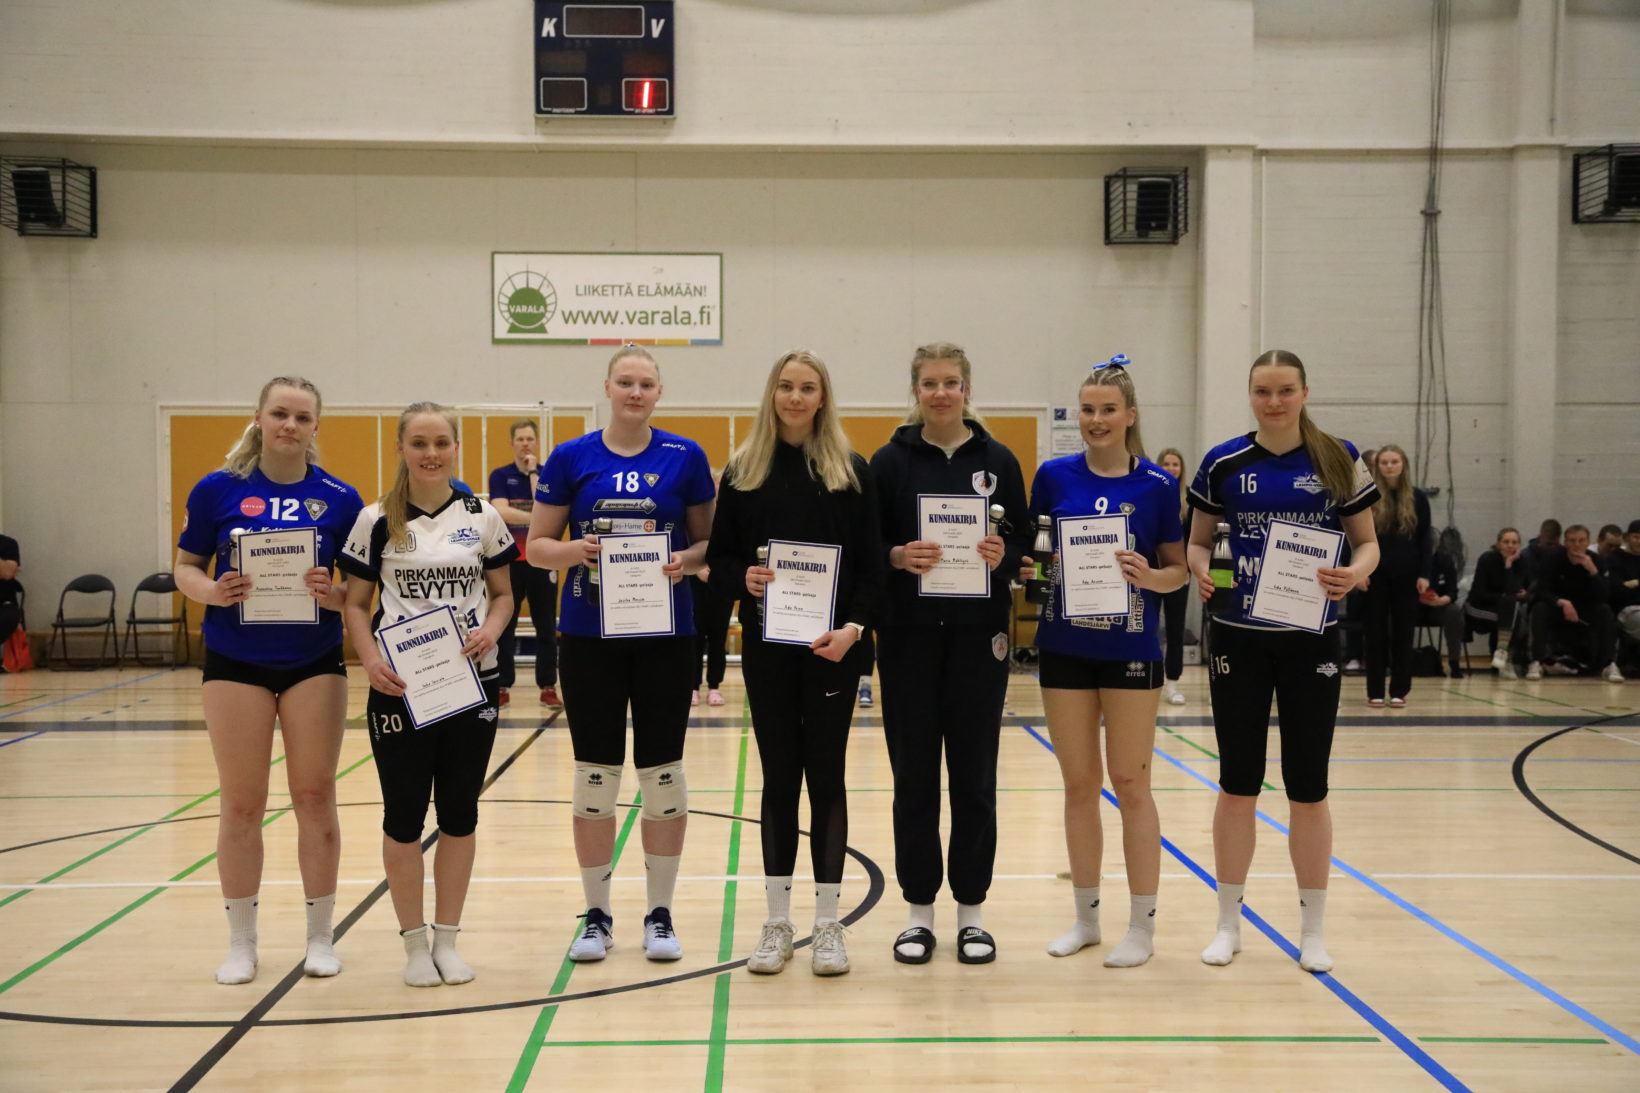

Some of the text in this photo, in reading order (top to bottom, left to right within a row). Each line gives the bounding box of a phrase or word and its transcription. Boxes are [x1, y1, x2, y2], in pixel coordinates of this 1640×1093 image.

[541, 17, 666, 38] K V
[642, 81, 650, 108] 1
[575, 282, 707, 297] LIIKETTÄ ELÄMÄÄN!
[509, 304, 546, 314] VARALA
[612, 471, 639, 493] 18
[1147, 469, 1167, 481] CRAFT
[1239, 473, 1257, 494] 16
[269, 497, 300, 521] 12
[1095, 496, 1108, 515] 9
[928, 514, 977, 525] KUNNIAKIRJA
[1237, 512, 1324, 524] PIRKANMAAN
[1070, 534, 1118, 546] KUNNIAKIRJA
[250, 545, 305, 557] KUNNIAKIRJA
[1275, 539, 1328, 559] KUNNIAKIRJA
[609, 552, 660, 563] KUNNIAKIRJA
[394, 565, 480, 581] PIRKANMAAN
[776, 560, 827, 574] KUNNIAKIRJA
[396, 626, 448, 653] KUNNIAKIRJA
[1215, 655, 1230, 674] 16
[380, 714, 403, 734] 20
[966, 928, 984, 936] NIKE
